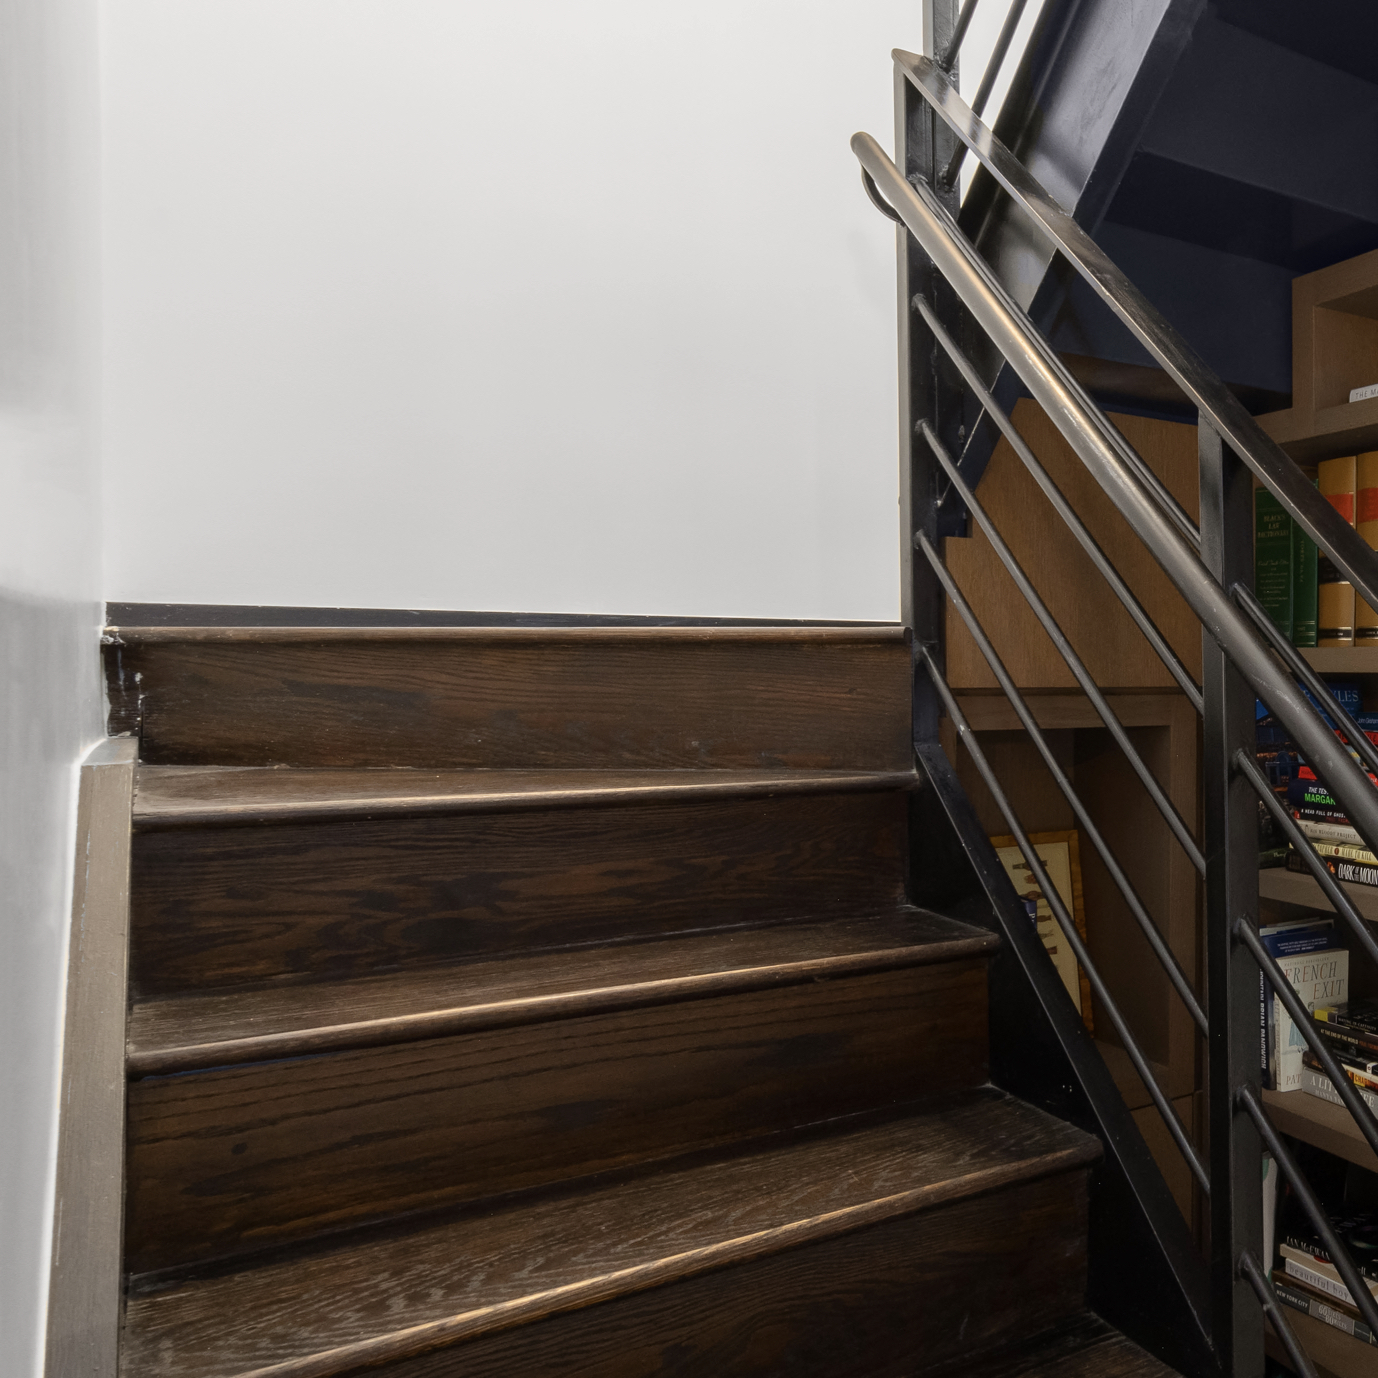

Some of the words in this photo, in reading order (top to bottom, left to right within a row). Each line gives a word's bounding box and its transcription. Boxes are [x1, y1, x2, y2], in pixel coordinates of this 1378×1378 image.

[1355, 391, 1368, 399] THE
[1338, 863, 1355, 881] DARK
[1360, 867, 1378, 886] MOON
[1313, 979, 1345, 1000] EXIT
[1285, 1235, 1301, 1248] IAN
[1288, 1263, 1330, 1291] beautiful
[1332, 1284, 1350, 1301] boy
[1286, 1293, 1298, 1303] YORK
[1297, 1298, 1309, 1309] CITY
